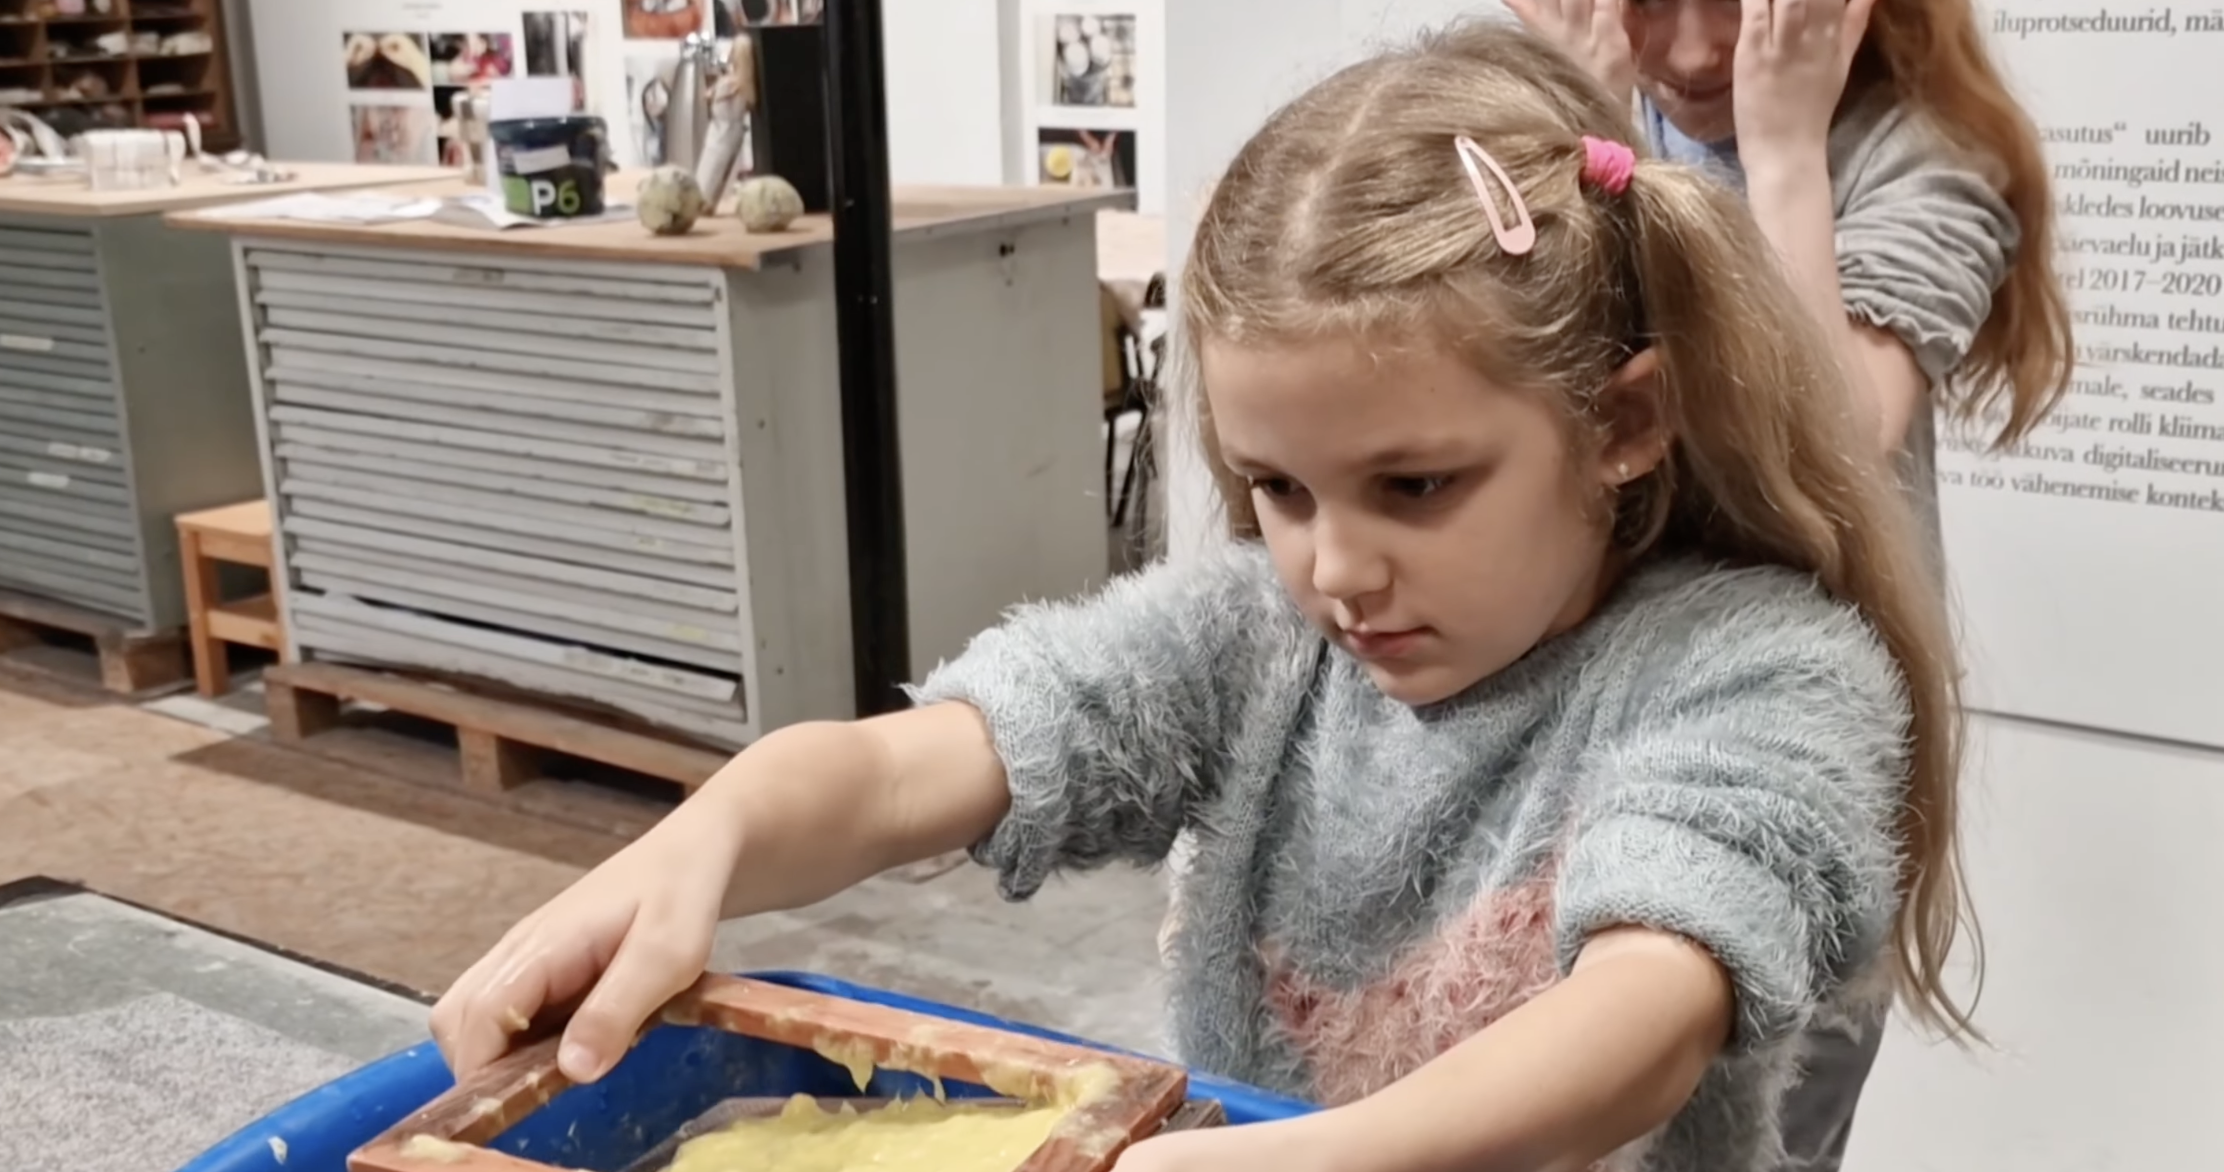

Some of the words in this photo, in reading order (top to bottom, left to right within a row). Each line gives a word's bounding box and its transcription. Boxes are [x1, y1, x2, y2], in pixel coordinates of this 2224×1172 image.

[1993, 8, 2177, 39] iluprotseduurid,
[2040, 121, 2127, 145] asutus“
[2145, 121, 2211, 146] uurib
[530, 178, 581, 216] P6
[2061, 193, 2135, 218] kledes
[2139, 195, 2224, 222] loovuse
[2149, 233, 2175, 264] ja
[2073, 303, 2160, 330] srühma
[2140, 380, 2215, 404] seades
[2108, 411, 2152, 436] rolli
[2082, 443, 2224, 477] digitaliseeru
[2010, 472, 2140, 504] vähenemise
